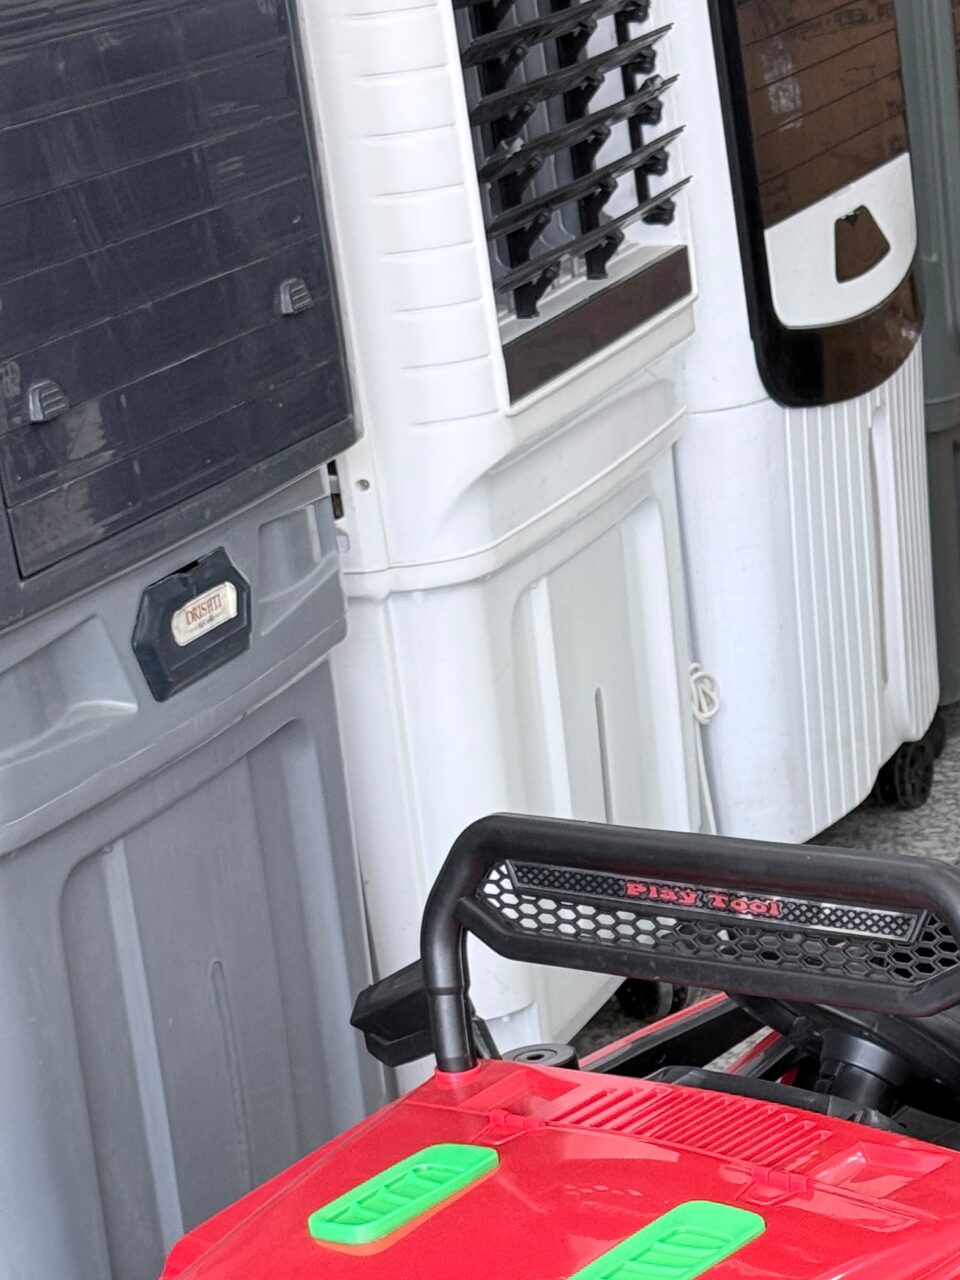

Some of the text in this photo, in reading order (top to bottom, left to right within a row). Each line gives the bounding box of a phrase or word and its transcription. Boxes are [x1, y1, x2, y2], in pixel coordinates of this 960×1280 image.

[185, 593, 222, 626] DRISHTI
[626, 881, 781, 917] Play Tool
